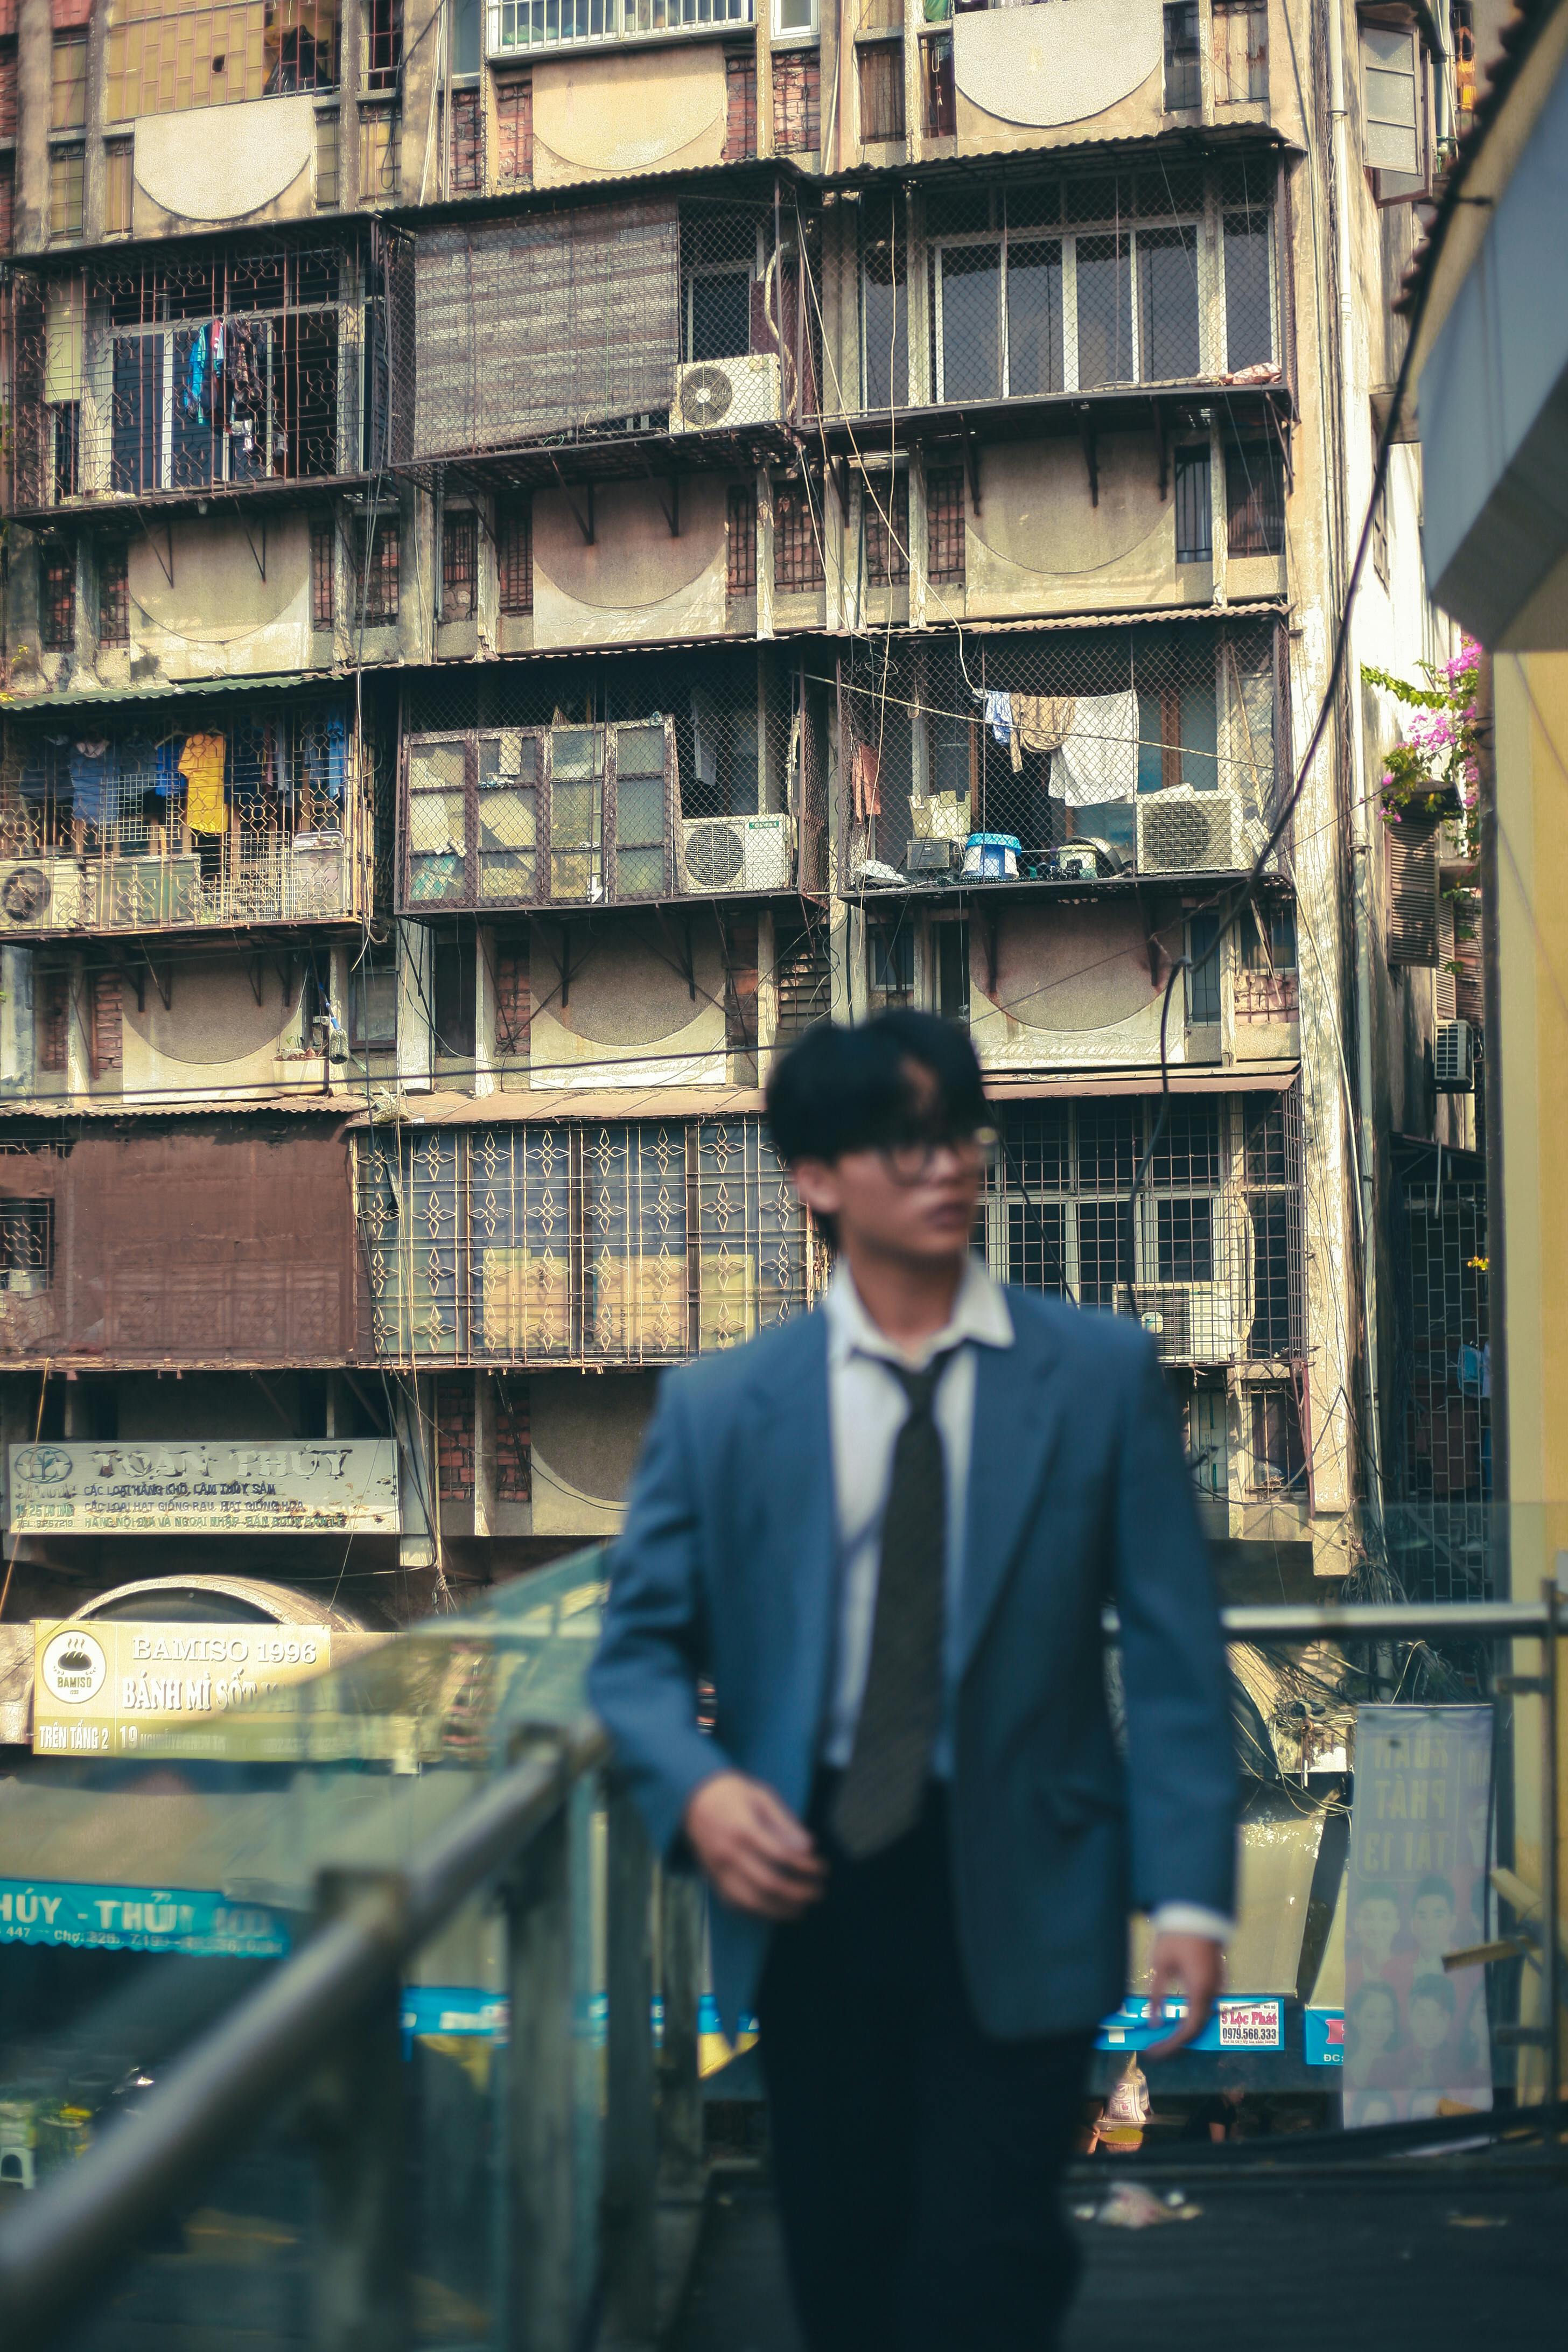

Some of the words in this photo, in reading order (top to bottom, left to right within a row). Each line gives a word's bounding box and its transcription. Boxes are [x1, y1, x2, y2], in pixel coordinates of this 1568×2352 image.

[132, 1636, 249, 1662] BAMISO
[257, 1640, 317, 1664] 1996
[57, 1677, 92, 1688] BAMISO
[122, 1670, 183, 1711] BÁNH
[186, 1671, 212, 1711] MÌ
[39, 1722, 67, 1749] TRÊN
[101, 1727, 109, 1749] 2
[120, 1725, 138, 1749] 19
[1230, 2011, 1249, 2028] Lộc
[1251, 2012, 1277, 2025] Phát
[1222, 2028, 1277, 2040] 0979.568.333
[1323, 2054, 1344, 2062] ĐC:
